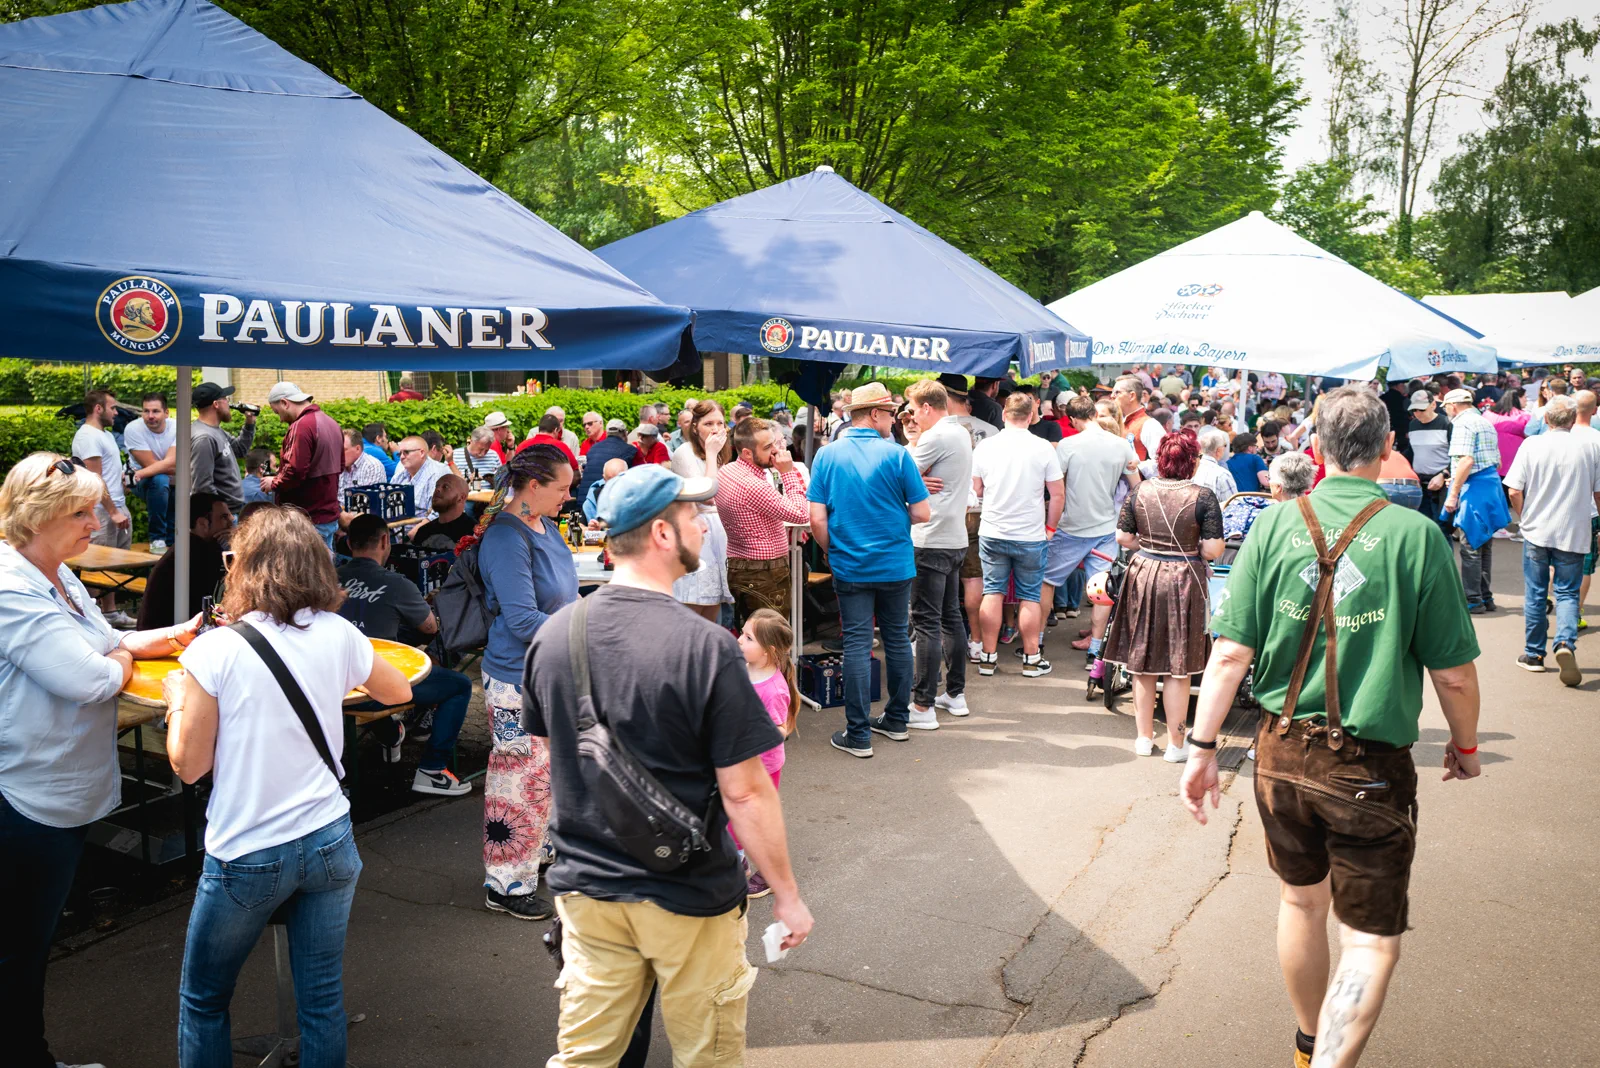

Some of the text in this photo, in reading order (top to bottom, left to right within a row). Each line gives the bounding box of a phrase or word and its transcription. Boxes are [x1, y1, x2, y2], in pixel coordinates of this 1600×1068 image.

[102, 279, 175, 308] PAULANER
[199, 293, 555, 350] PAULANER
[110, 329, 170, 351] MÜNCHEN
[798, 325, 952, 363] PAULANER
[1092, 341, 1115, 356] Der
[1169, 342, 1191, 356] der
[1193, 342, 1248, 362] Bayern
